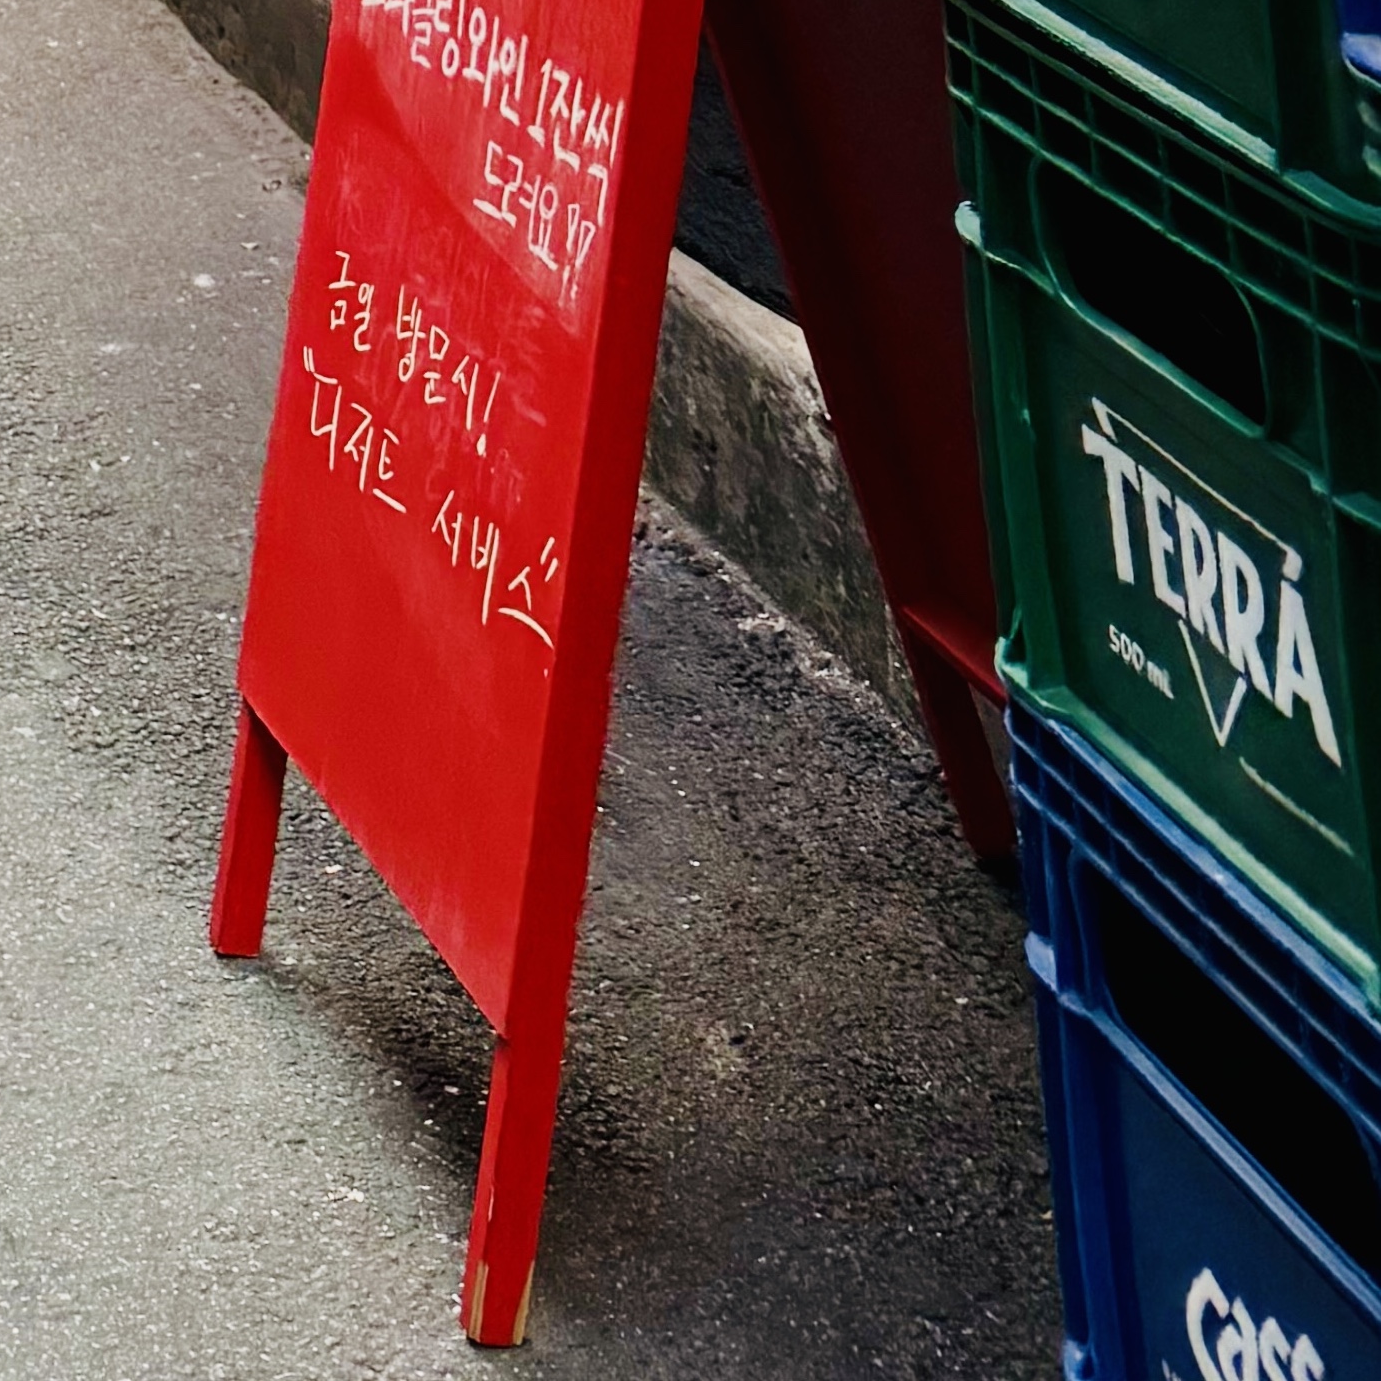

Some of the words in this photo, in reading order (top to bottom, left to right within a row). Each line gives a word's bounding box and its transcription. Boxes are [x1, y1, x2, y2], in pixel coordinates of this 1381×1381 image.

[328, 250, 375, 353] 금일
[1081, 422, 1342, 768] TERRA
[1109, 623, 1146, 676] 500
